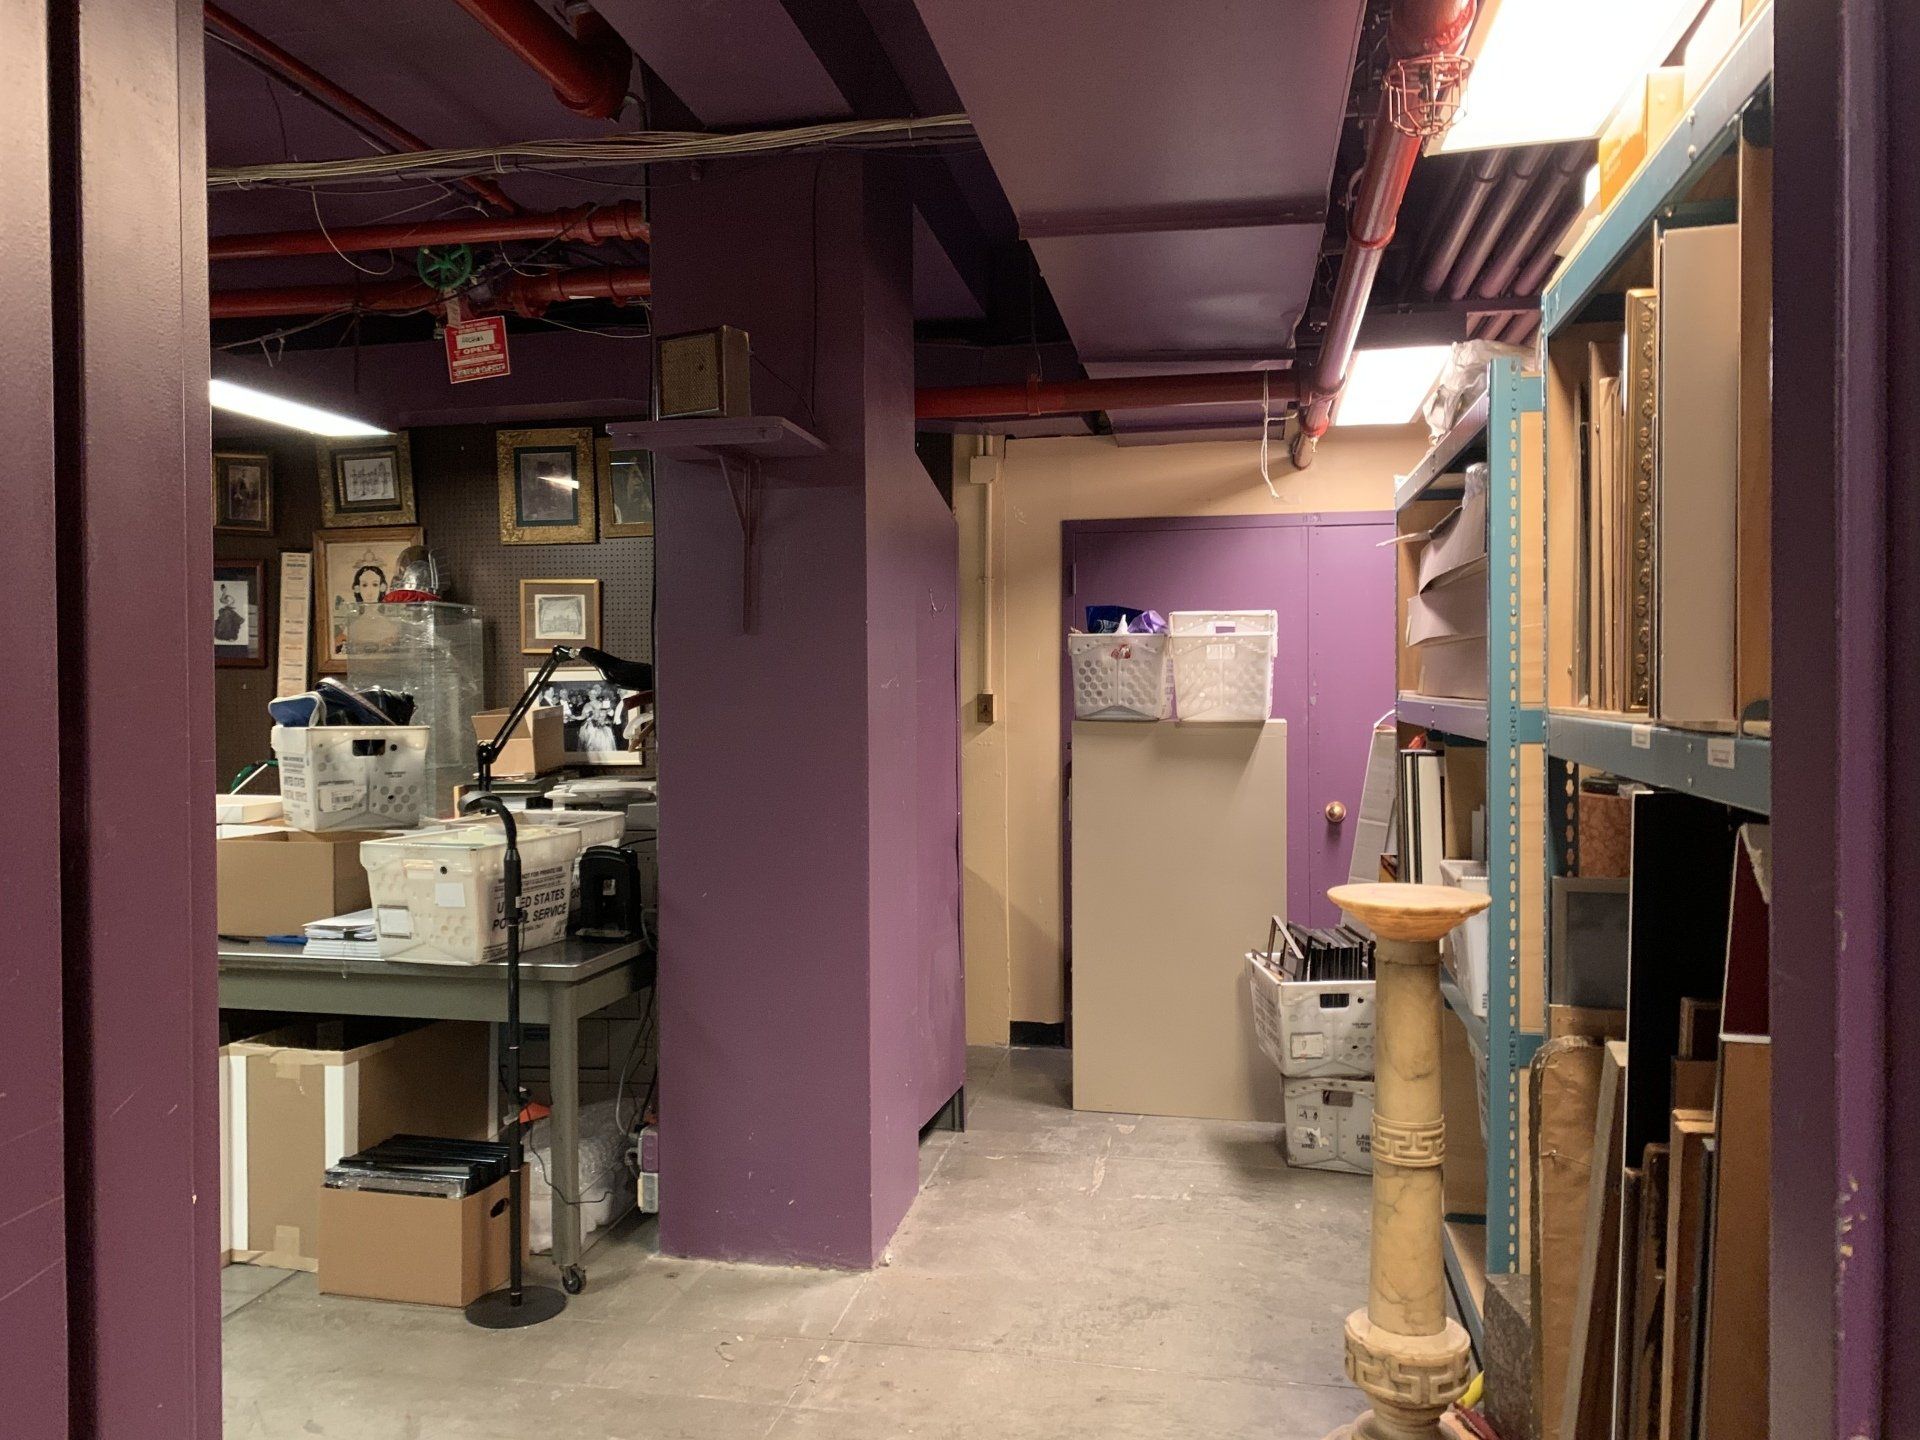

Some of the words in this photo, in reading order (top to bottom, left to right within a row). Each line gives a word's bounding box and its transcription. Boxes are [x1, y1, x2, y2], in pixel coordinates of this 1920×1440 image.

[463, 345, 490, 354] OPEN
[497, 896, 531, 914] UED
[534, 888, 565, 906] STATES
[533, 903, 566, 921] SERVICE
